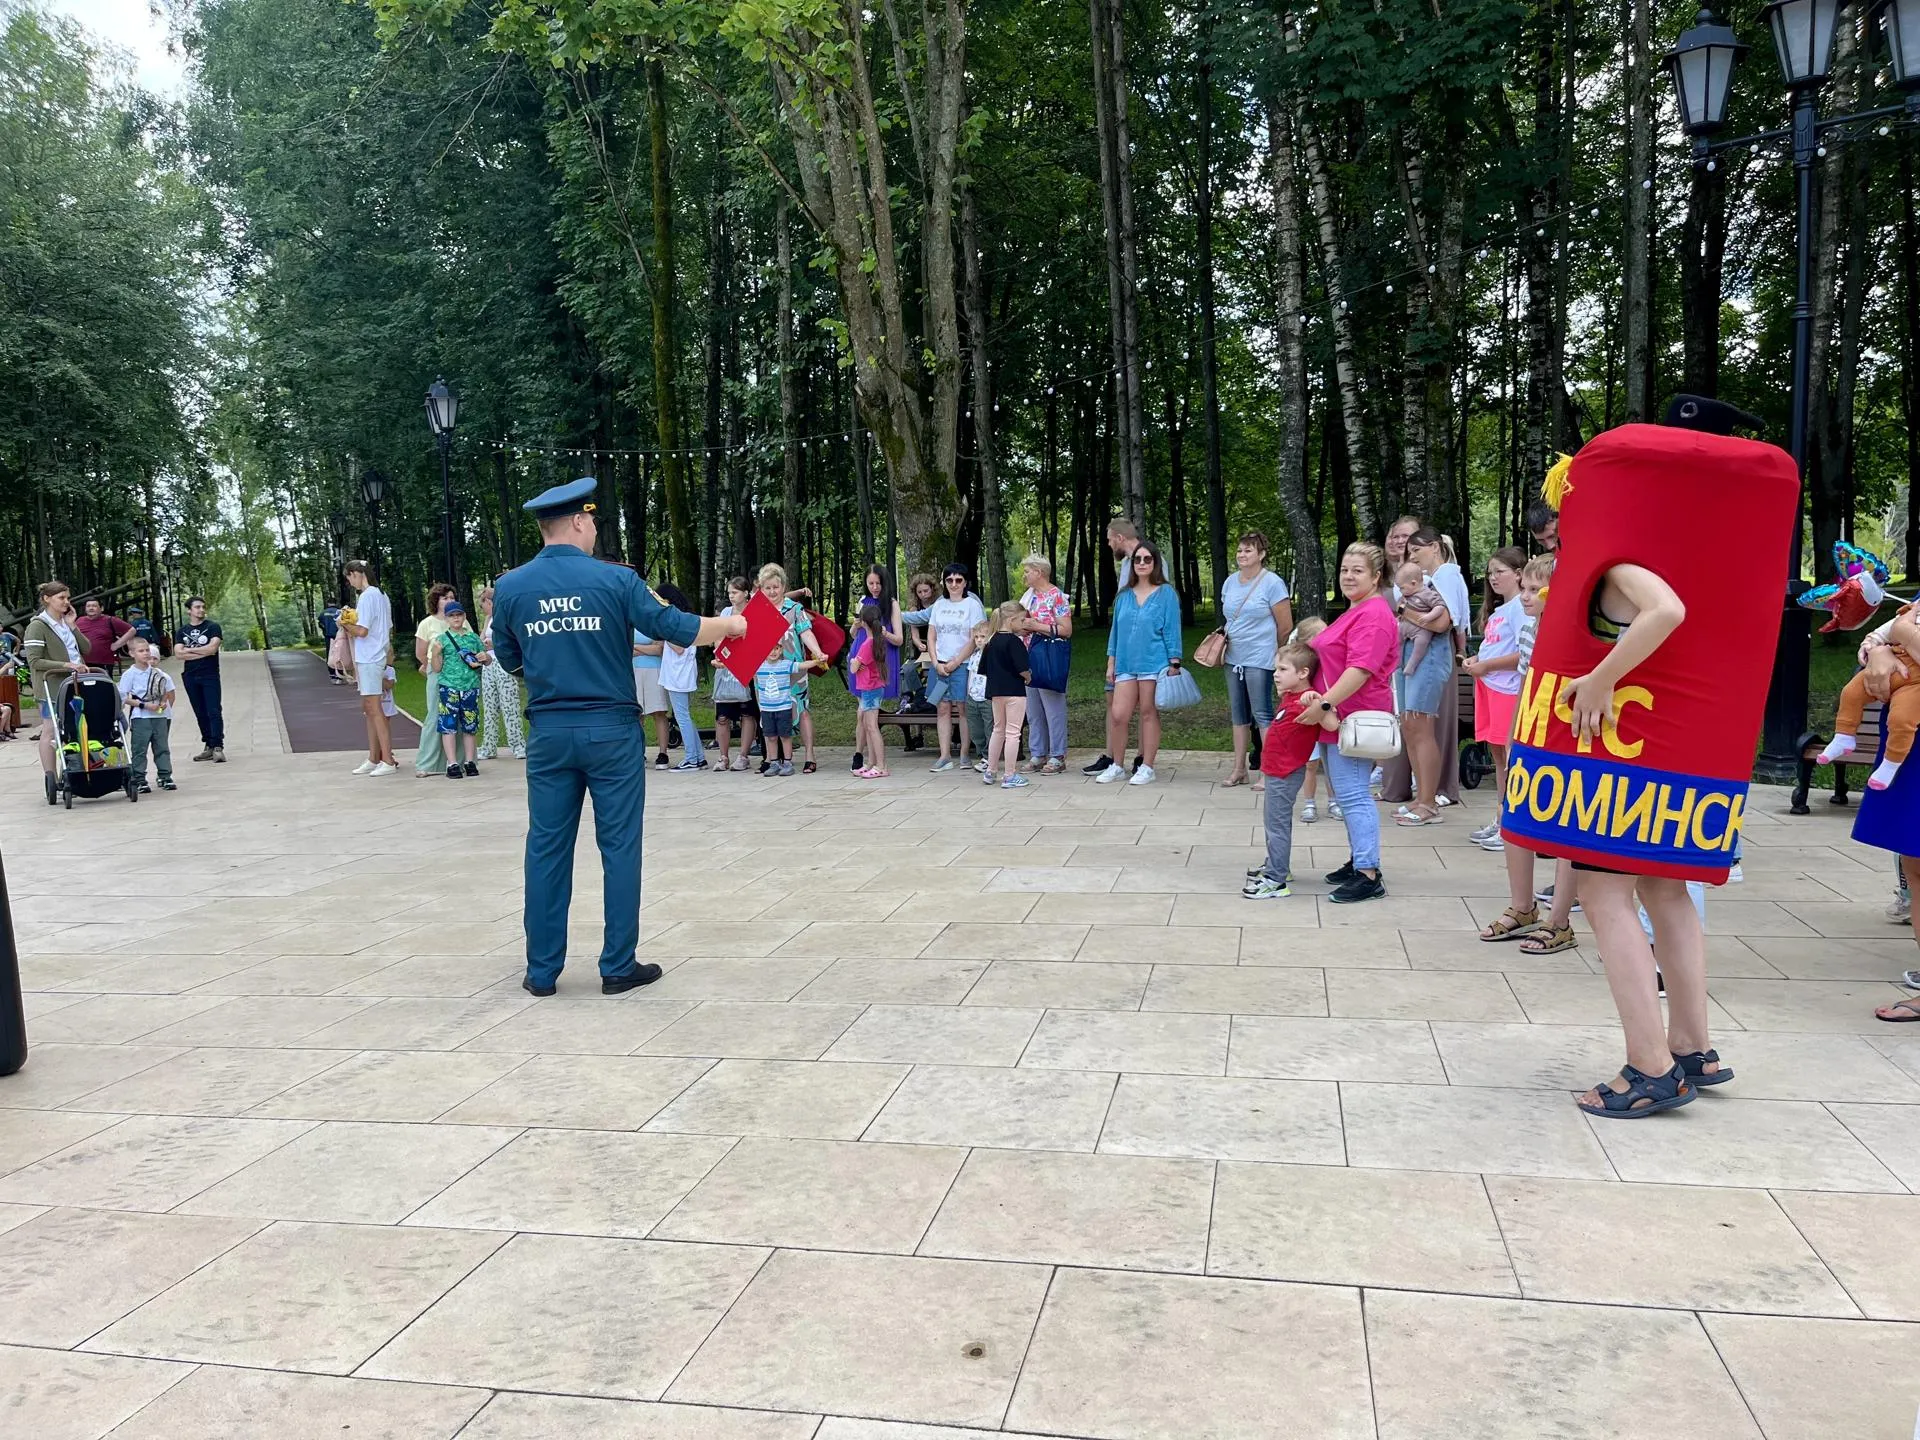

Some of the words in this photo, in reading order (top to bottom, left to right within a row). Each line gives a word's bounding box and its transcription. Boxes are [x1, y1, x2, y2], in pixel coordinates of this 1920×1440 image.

[538, 596, 582, 614] МЧС
[524, 617, 602, 637] РОССИИ
[1513, 667, 1654, 759] МЧС
